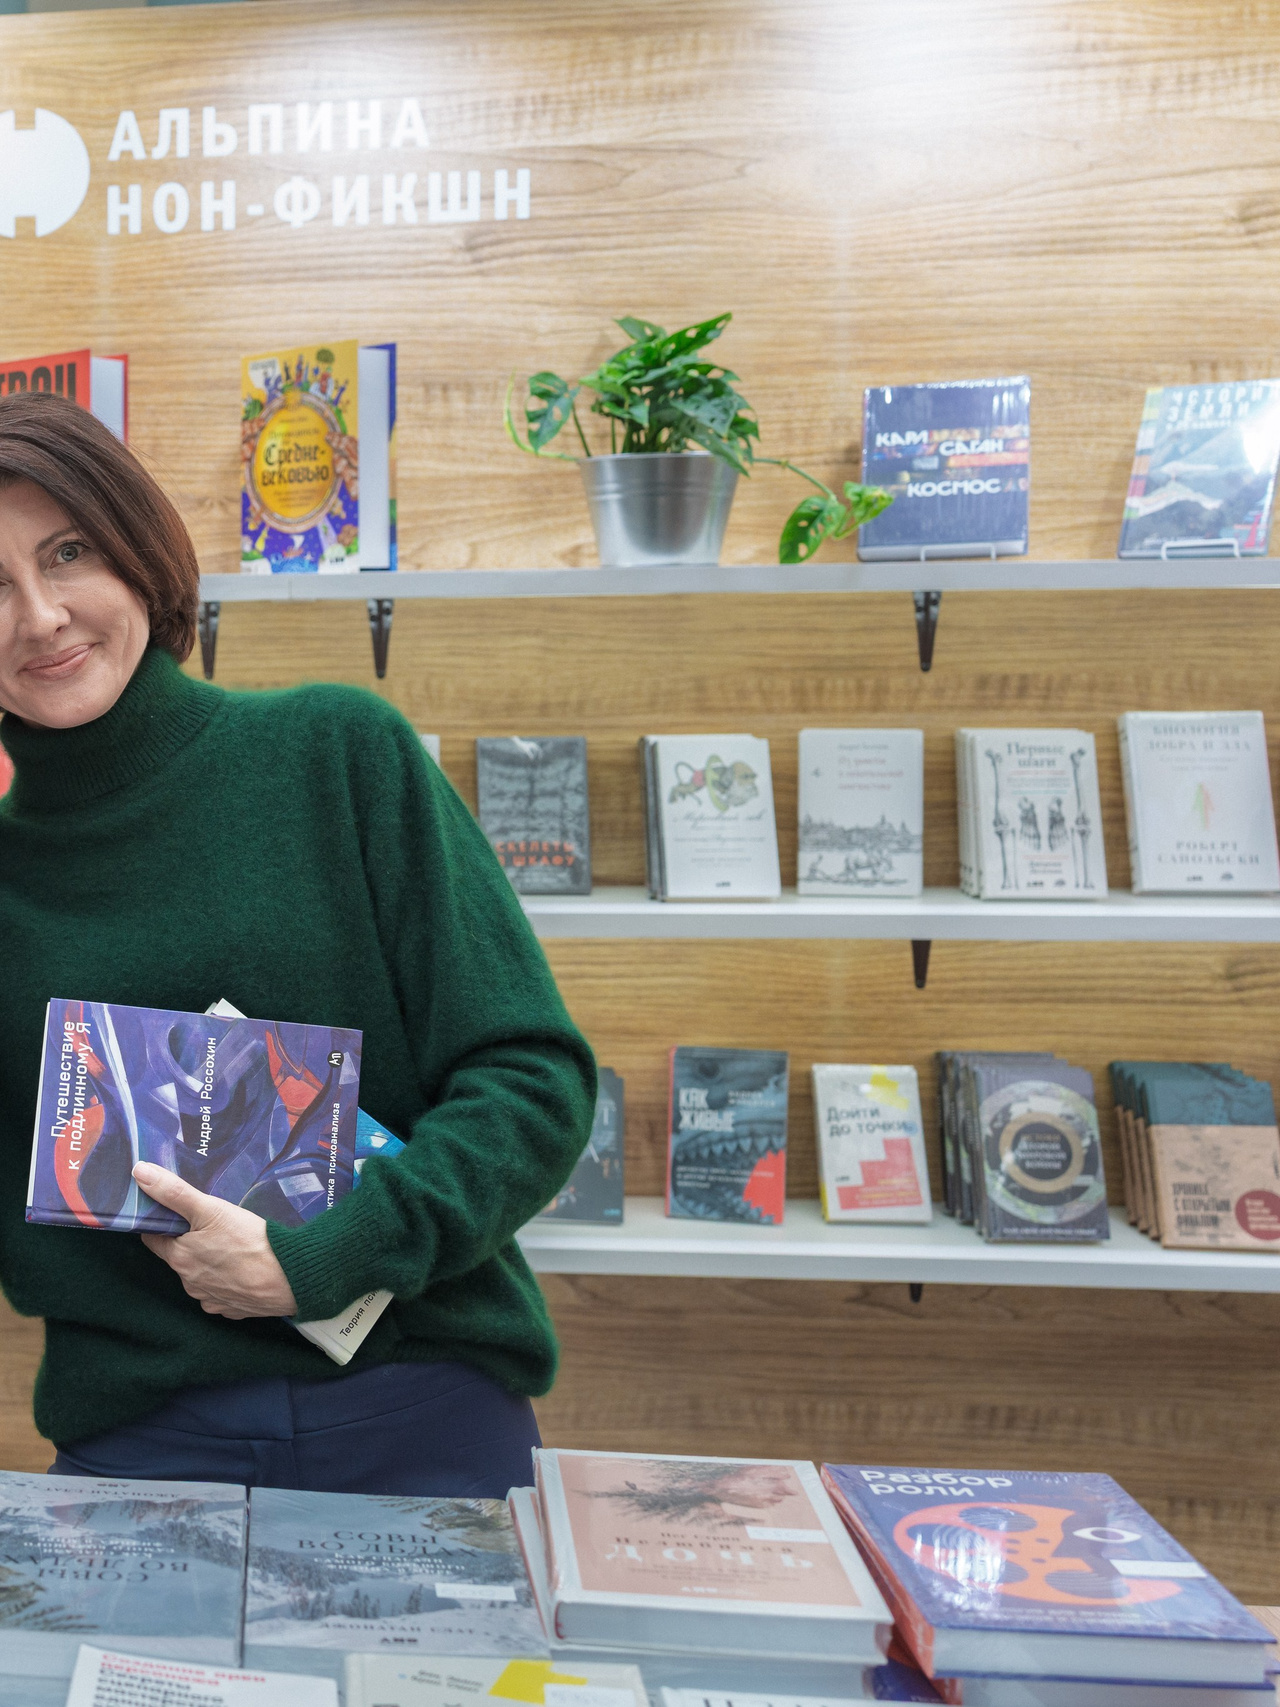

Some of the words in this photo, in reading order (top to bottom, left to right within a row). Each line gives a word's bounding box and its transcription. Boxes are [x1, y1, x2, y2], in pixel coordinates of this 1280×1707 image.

[107, 97, 430, 161] АЛЬПИНА
[107, 168, 532, 236] НОН-ФИКШН
[939, 438, 1004, 457] САГАН
[907, 478, 1002, 498] КОСМОС
[495, 840, 575, 853] СКЕЛЕТЫ
[512, 854, 575, 867] ШКАФУ
[75, 1022, 91, 1034] Я
[200, 1037, 217, 1100] Россохин
[51, 1021, 75, 1138] Путешествие
[70, 1042, 94, 1151] подлинному
[679, 1088, 709, 1109] КАК
[196, 1106, 213, 1157] Андрей
[329, 1102, 341, 1175] психоанализа
[830, 1124, 851, 1137] до
[68, 1159, 80, 1170] к
[327, 1178, 336, 1210] ктика
[340, 1307, 365, 1337] Теория
[859, 1470, 1014, 1489] Разбор
[869, 1484, 975, 1498] роли
[334, 1530, 438, 1544] СОВЫ
[298, 1539, 344, 1550] ВО
[358, 1543, 479, 1557] ЛЬДАХ
[39, 1569, 150, 1582] СОВЫ
[139, 1560, 189, 1572] ВО
